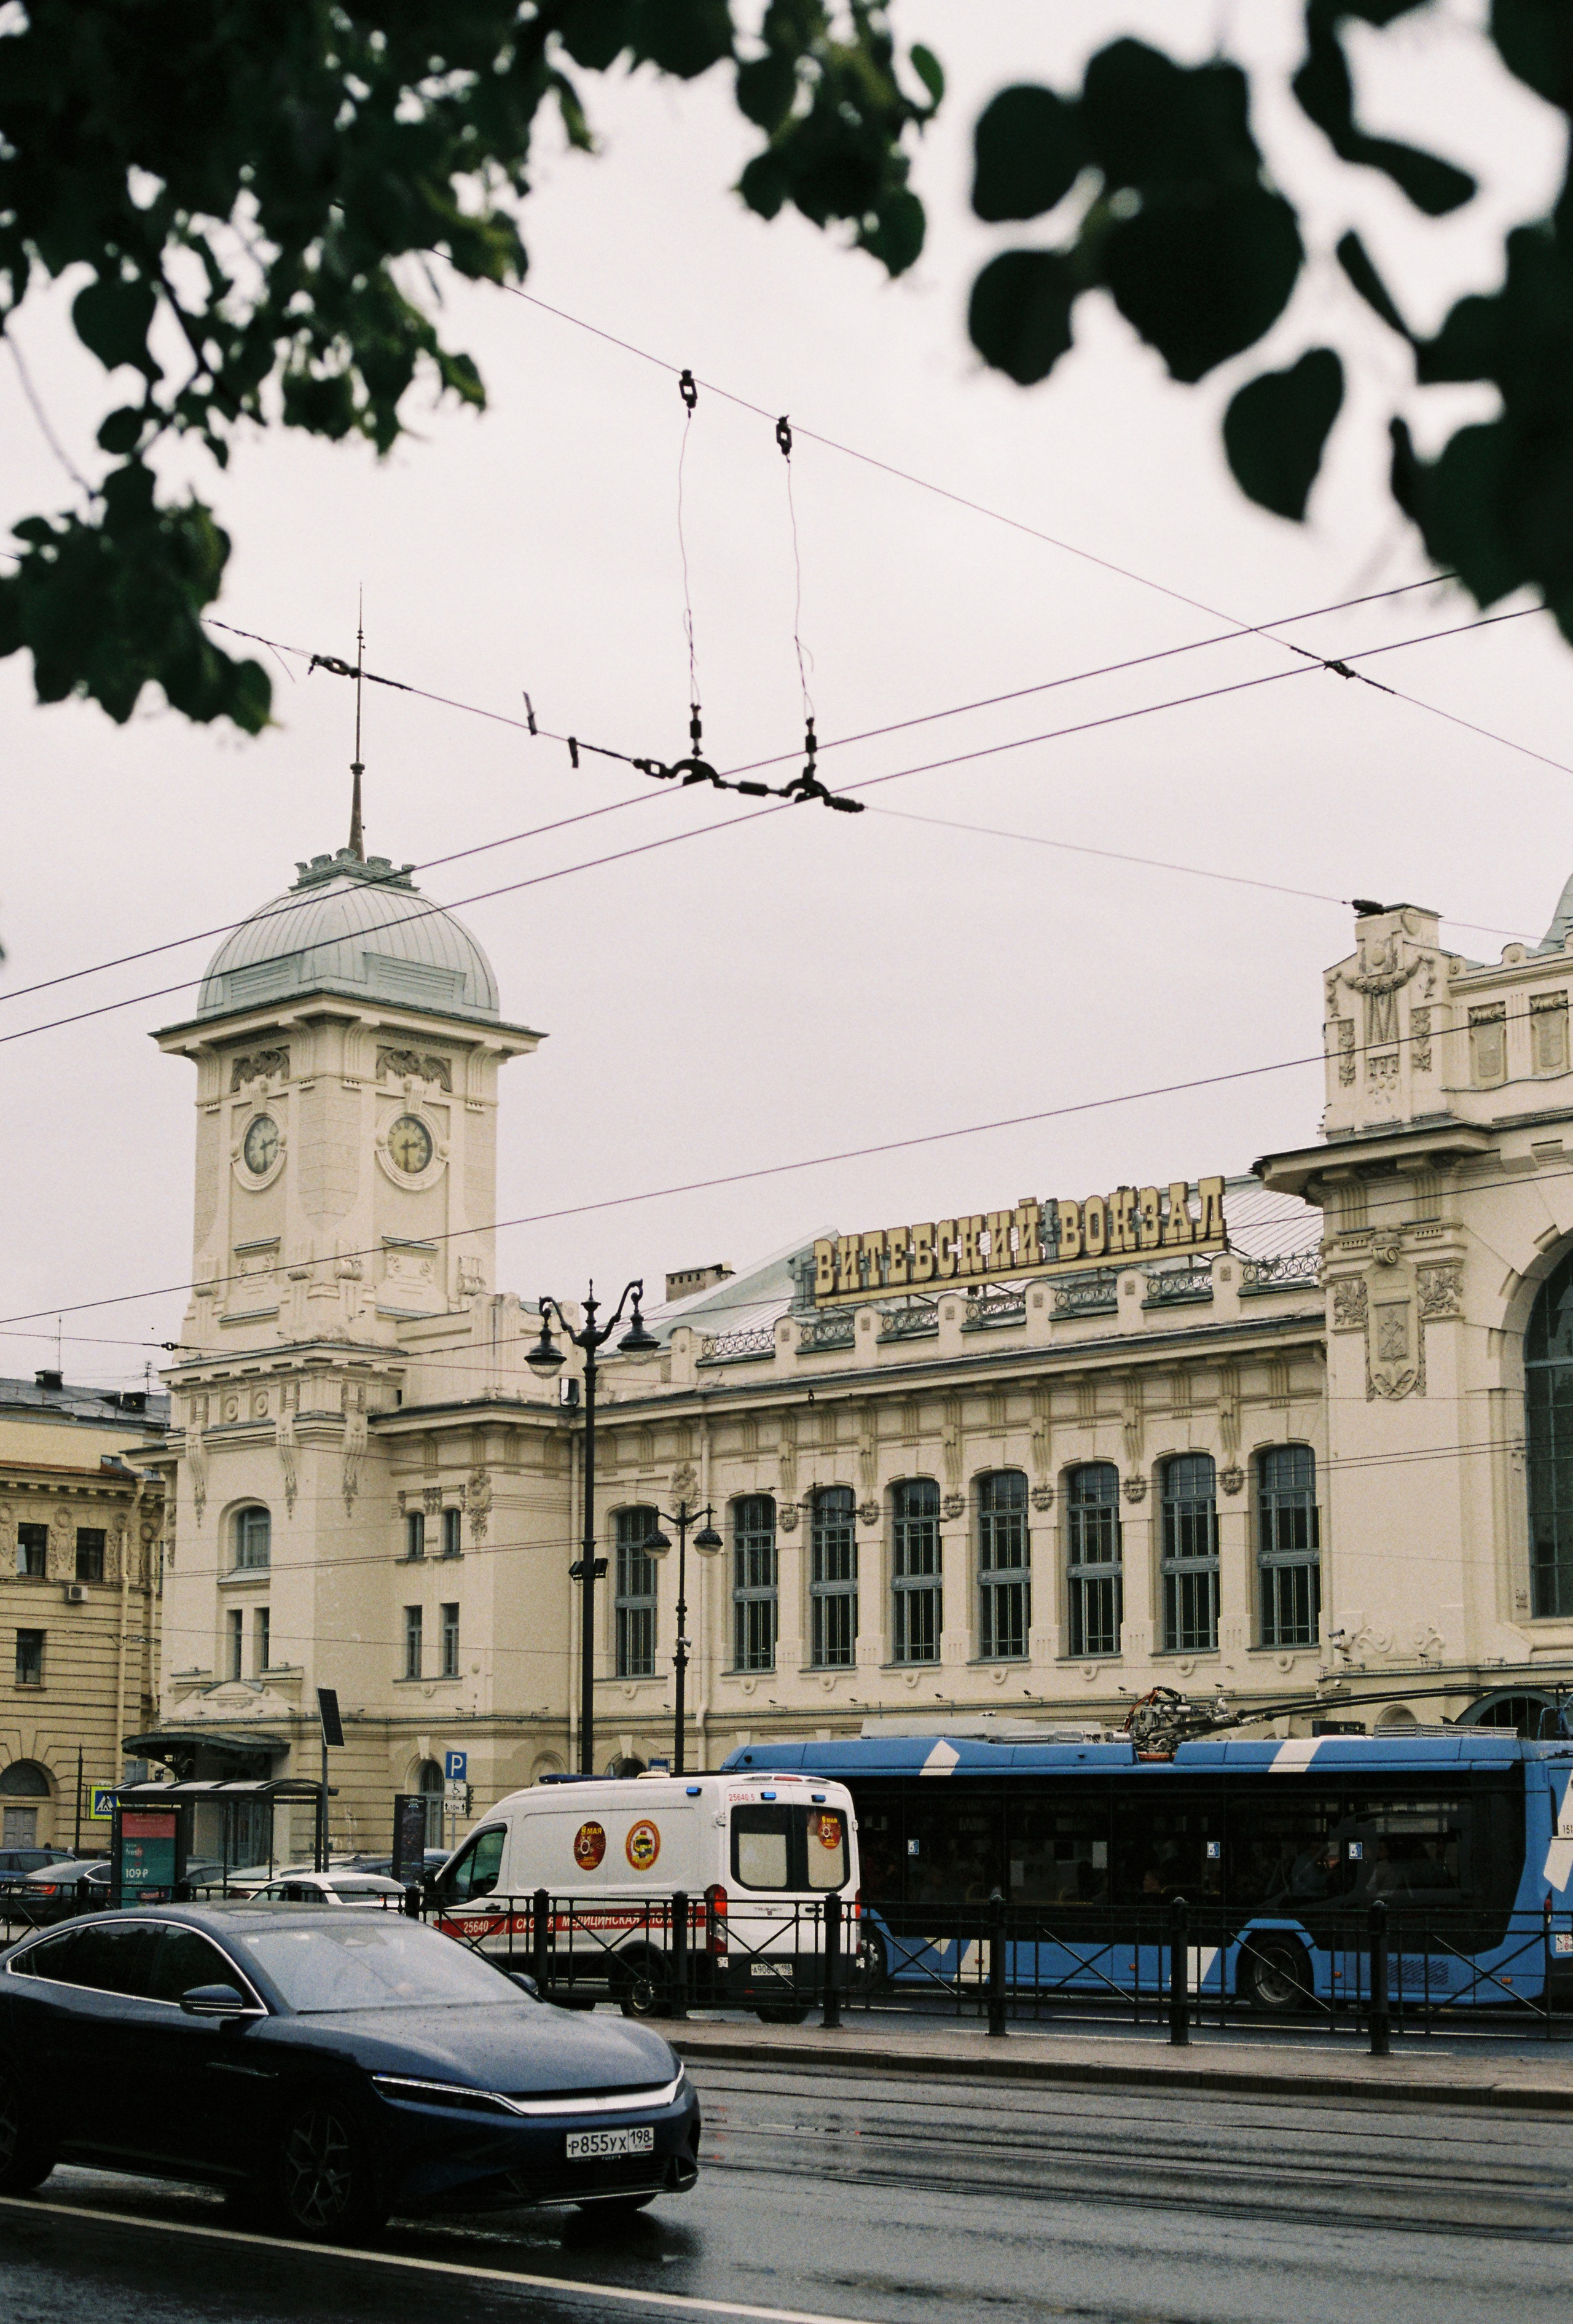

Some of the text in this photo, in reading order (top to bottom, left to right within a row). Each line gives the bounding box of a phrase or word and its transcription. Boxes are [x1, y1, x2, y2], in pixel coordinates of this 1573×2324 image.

[814, 1176, 1228, 1296] ВИТЕБСКИЙ ВОКЗАЛ
[450, 1755, 463, 1777] P
[728, 1793, 748, 1802] 25640
[581, 1825, 586, 1836] 9
[125, 1868, 141, 1879] 109
[463, 1920, 489, 1933] 25640
